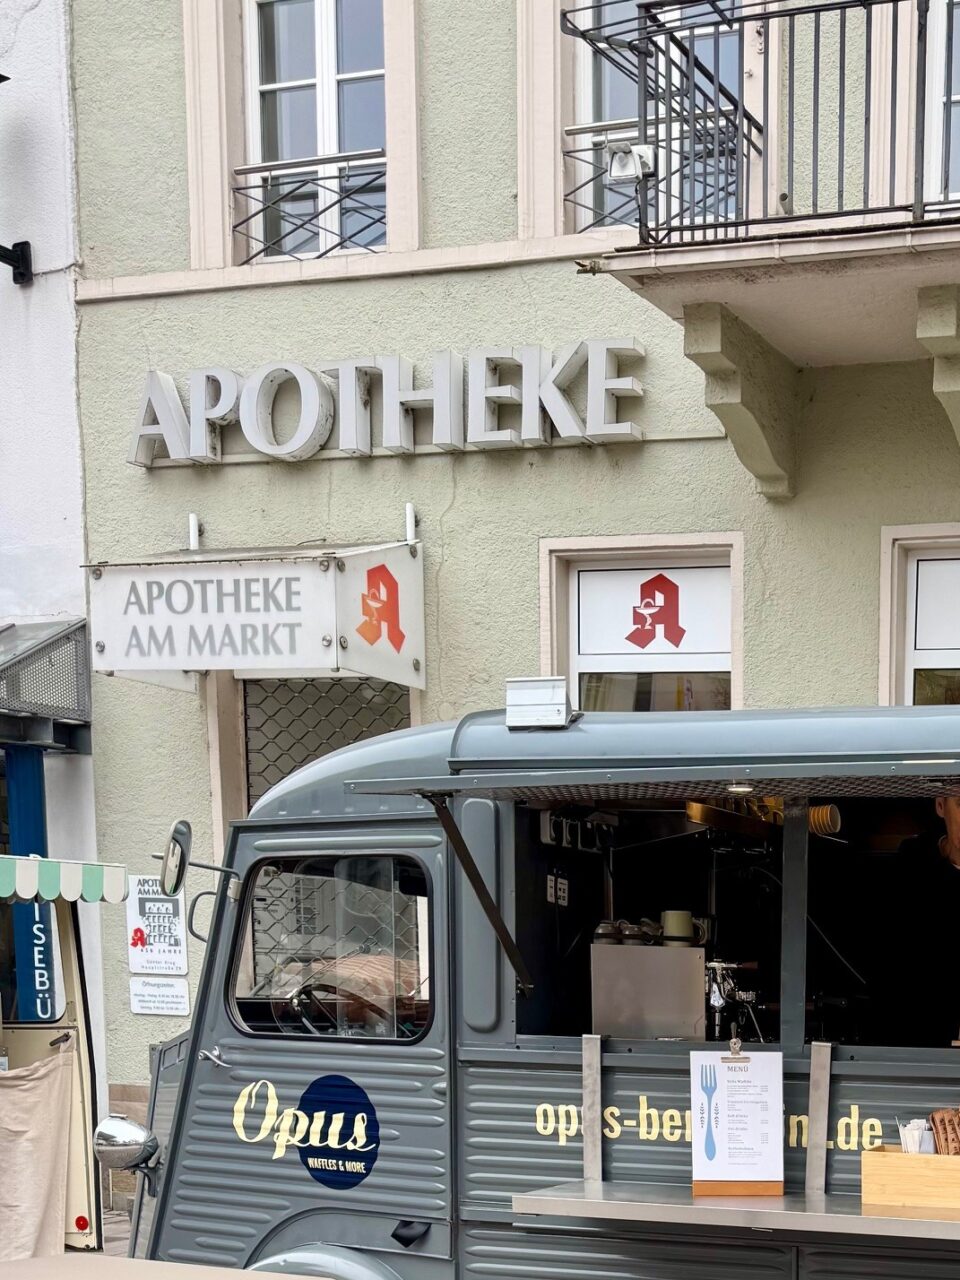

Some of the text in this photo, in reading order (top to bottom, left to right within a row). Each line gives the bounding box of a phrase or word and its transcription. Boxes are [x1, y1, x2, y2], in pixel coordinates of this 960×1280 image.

[127, 336, 646, 468] APOTHEKE
[124, 576, 302, 616] APOTHEKE
[125, 622, 302, 658] AM MARKT
[137, 878, 162, 888] APOT
[138, 888, 150, 896] AM
[32, 902, 52, 1019] ISEBÜ
[727, 1065, 749, 1073] MENÜ
[232, 1079, 376, 1160] Opus
[307, 1157, 367, 1173] WAFFLES & MORE
